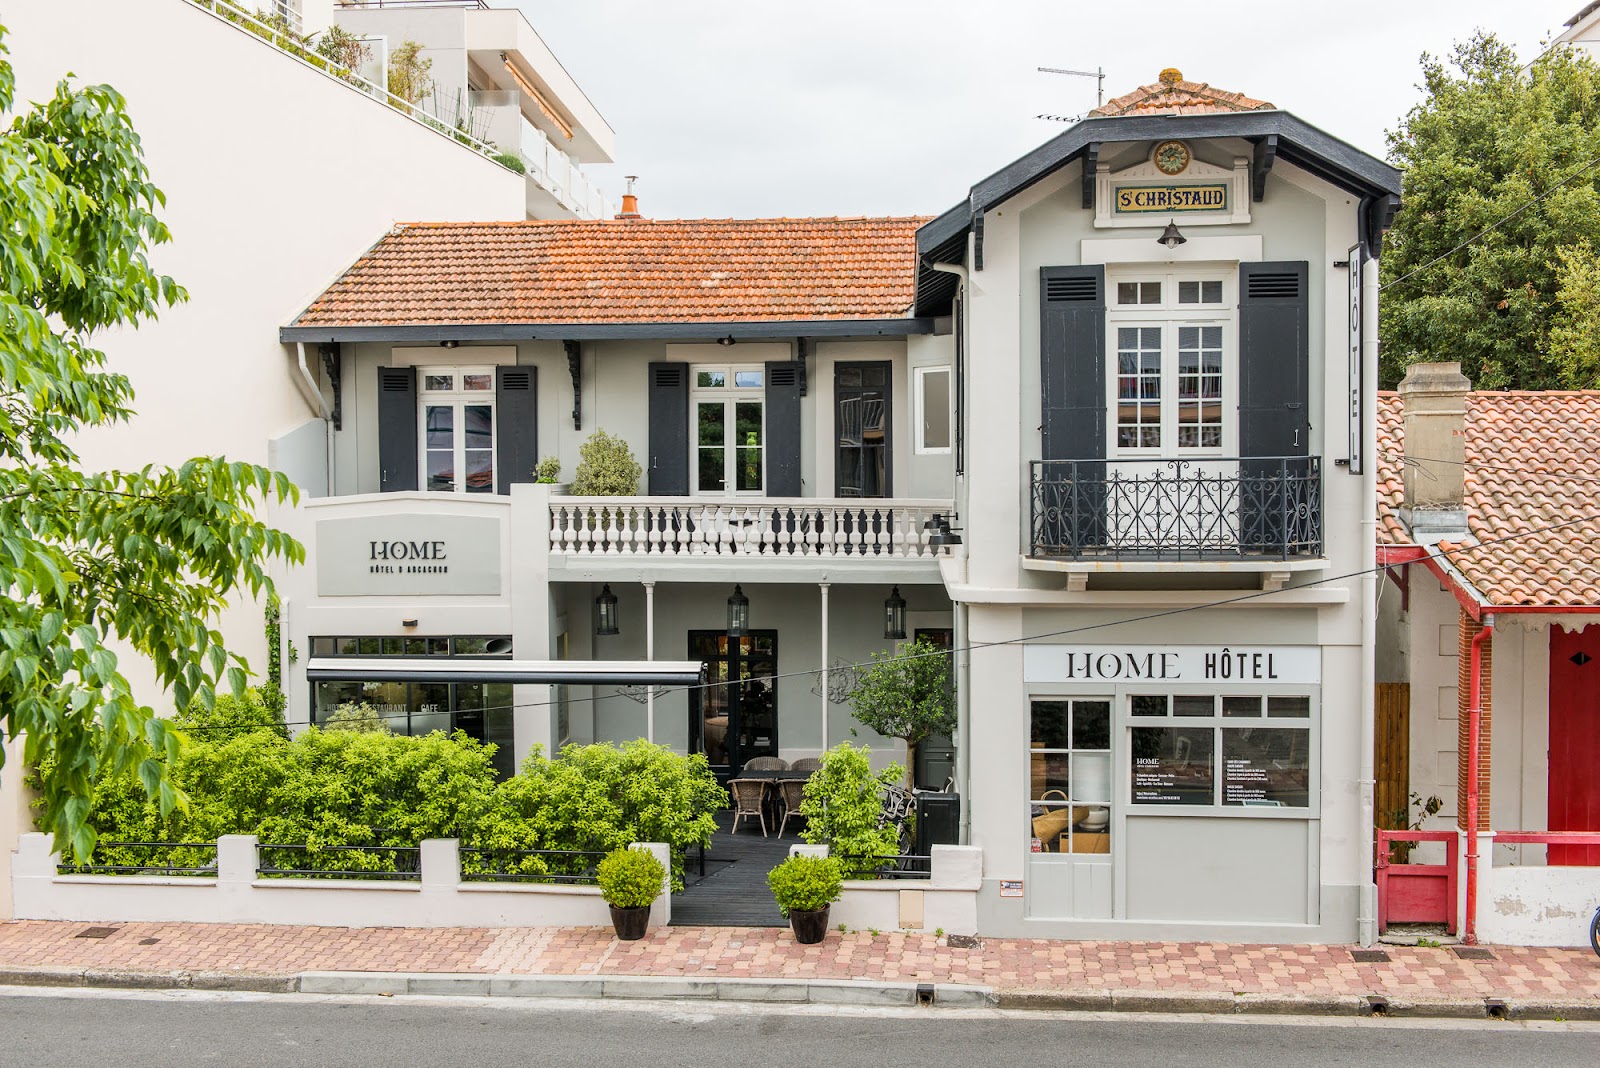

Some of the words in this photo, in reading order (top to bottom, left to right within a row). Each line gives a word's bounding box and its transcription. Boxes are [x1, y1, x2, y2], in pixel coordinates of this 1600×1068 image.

[1135, 187, 1223, 207] CHRISTAUD
[369, 541, 447, 560] HOME
[370, 564, 394, 574] HÔTEL
[1066, 652, 1182, 679] HOME
[1205, 647, 1278, 679] HÔTEL
